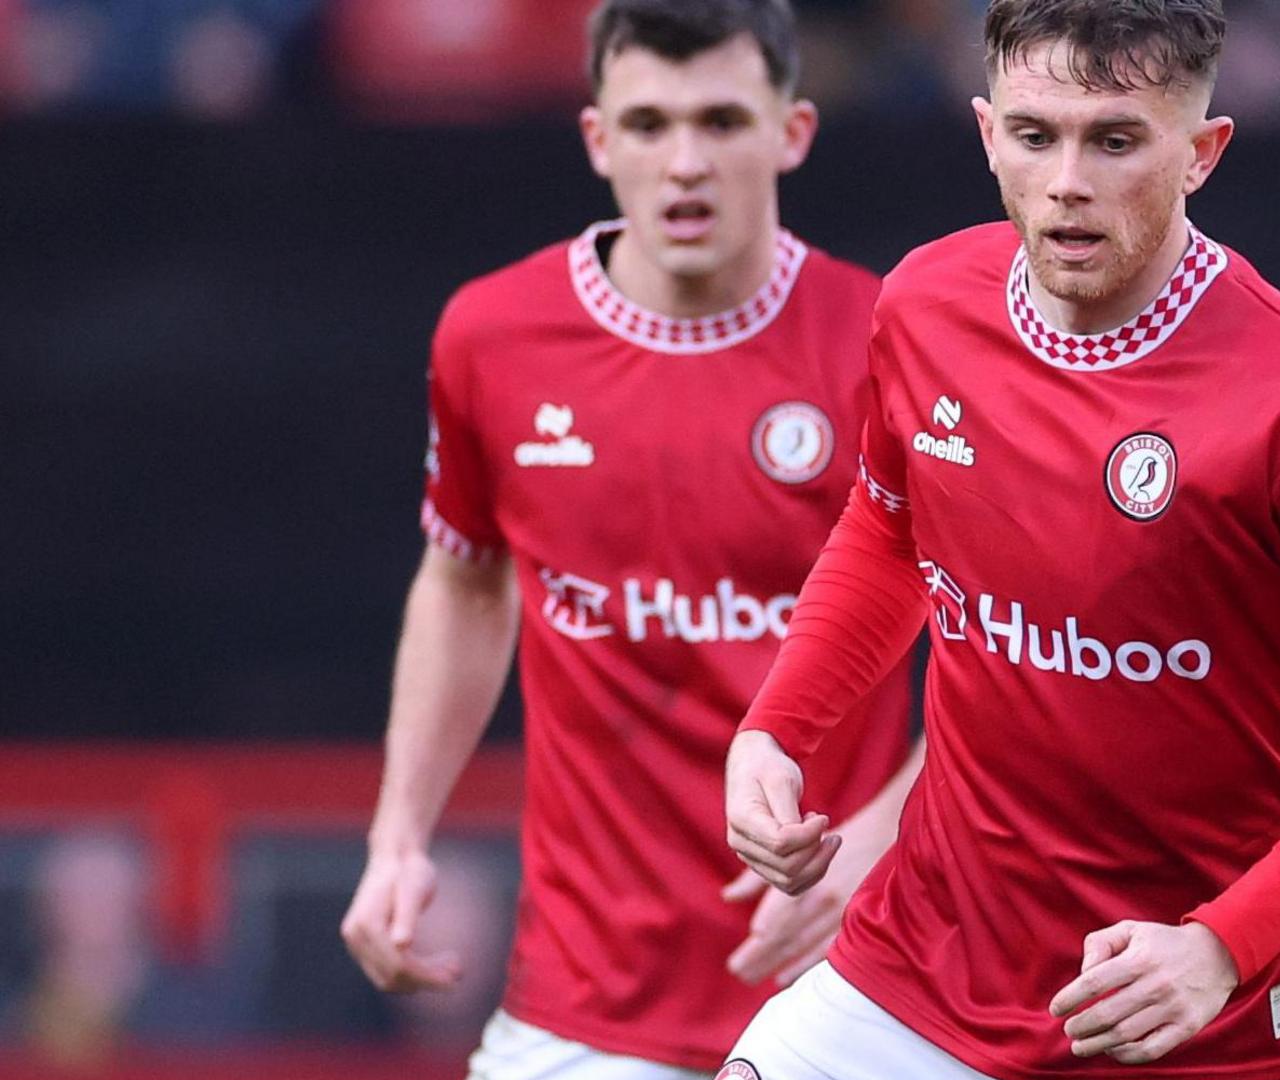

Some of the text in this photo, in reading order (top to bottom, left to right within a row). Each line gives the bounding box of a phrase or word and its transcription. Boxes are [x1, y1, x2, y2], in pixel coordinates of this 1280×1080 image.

[1124, 438, 1171, 461] BRISTOL
[1125, 500, 1155, 513] CITY
[623, 578, 802, 643] Hubo
[978, 593, 1212, 682] Huboo
